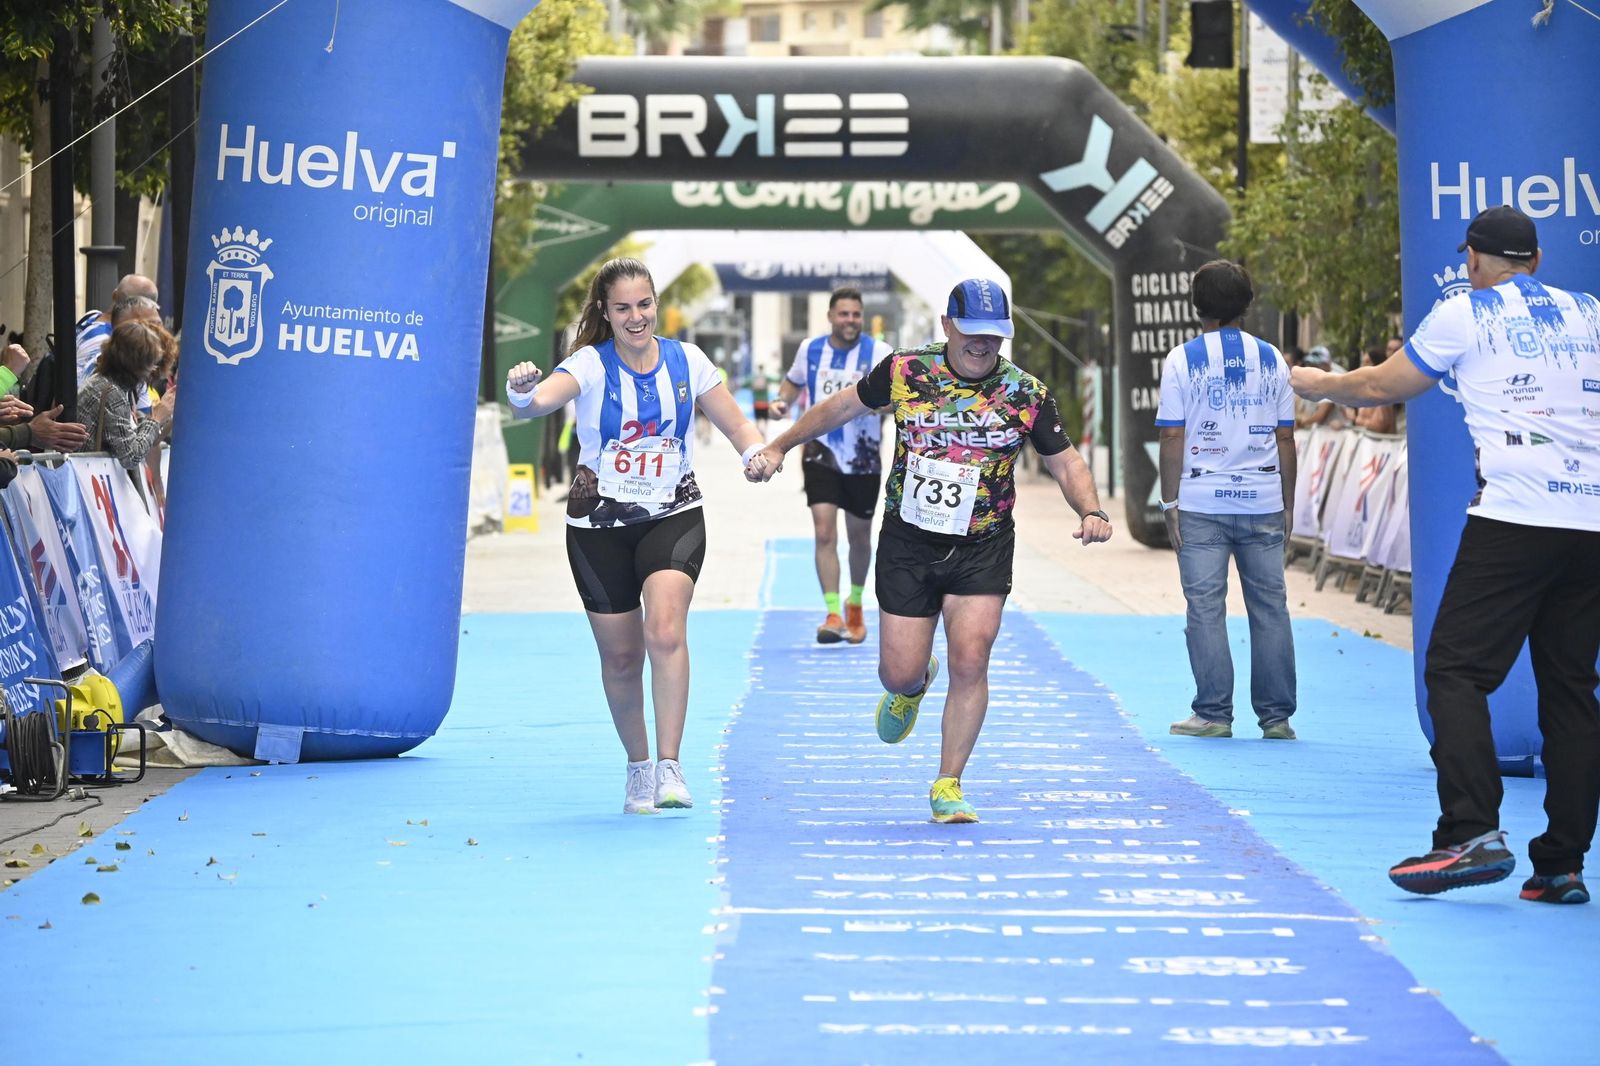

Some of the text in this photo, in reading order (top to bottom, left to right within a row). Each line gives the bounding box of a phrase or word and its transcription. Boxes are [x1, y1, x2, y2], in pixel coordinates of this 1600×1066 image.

[216, 124, 438, 197] Huelva
[353, 201, 434, 228] original
[281, 300, 424, 326] Ayuntamiento de
[278, 323, 420, 361] HUELVA
[823, 380, 853, 395] 61
[903, 411, 1007, 428] HUELVA
[614, 450, 663, 478] 611
[617, 485, 652, 496] Huelva
[912, 474, 962, 508] 733
[914, 511, 945, 527] Huelva
